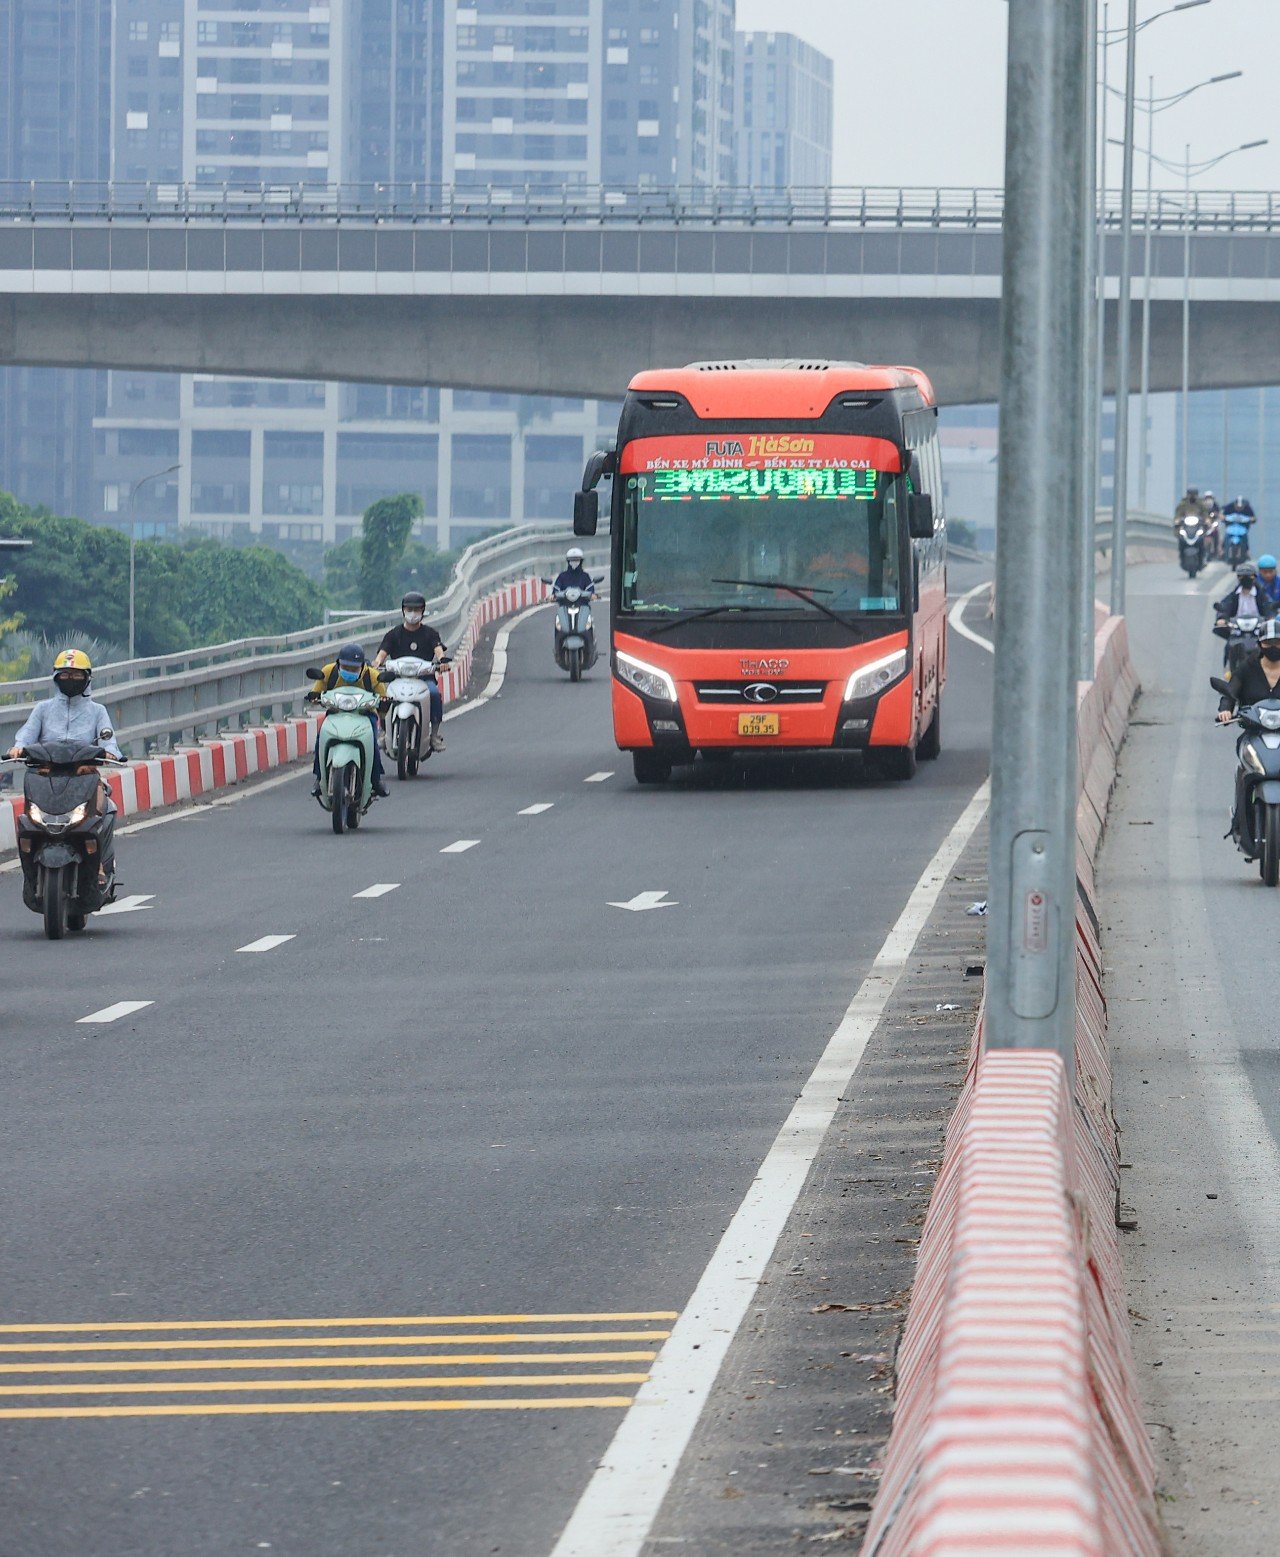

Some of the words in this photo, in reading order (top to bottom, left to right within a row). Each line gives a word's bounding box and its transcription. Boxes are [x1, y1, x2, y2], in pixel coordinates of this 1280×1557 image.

[706, 442, 743, 456] FUTA
[646, 457, 670, 469] BẾN
[673, 460, 689, 469] XE
[764, 457, 787, 468] BẾN
[790, 459, 806, 468] XE
[808, 459, 822, 468] TT
[825, 458, 848, 468] LÀO
[850, 459, 870, 468] CAI
